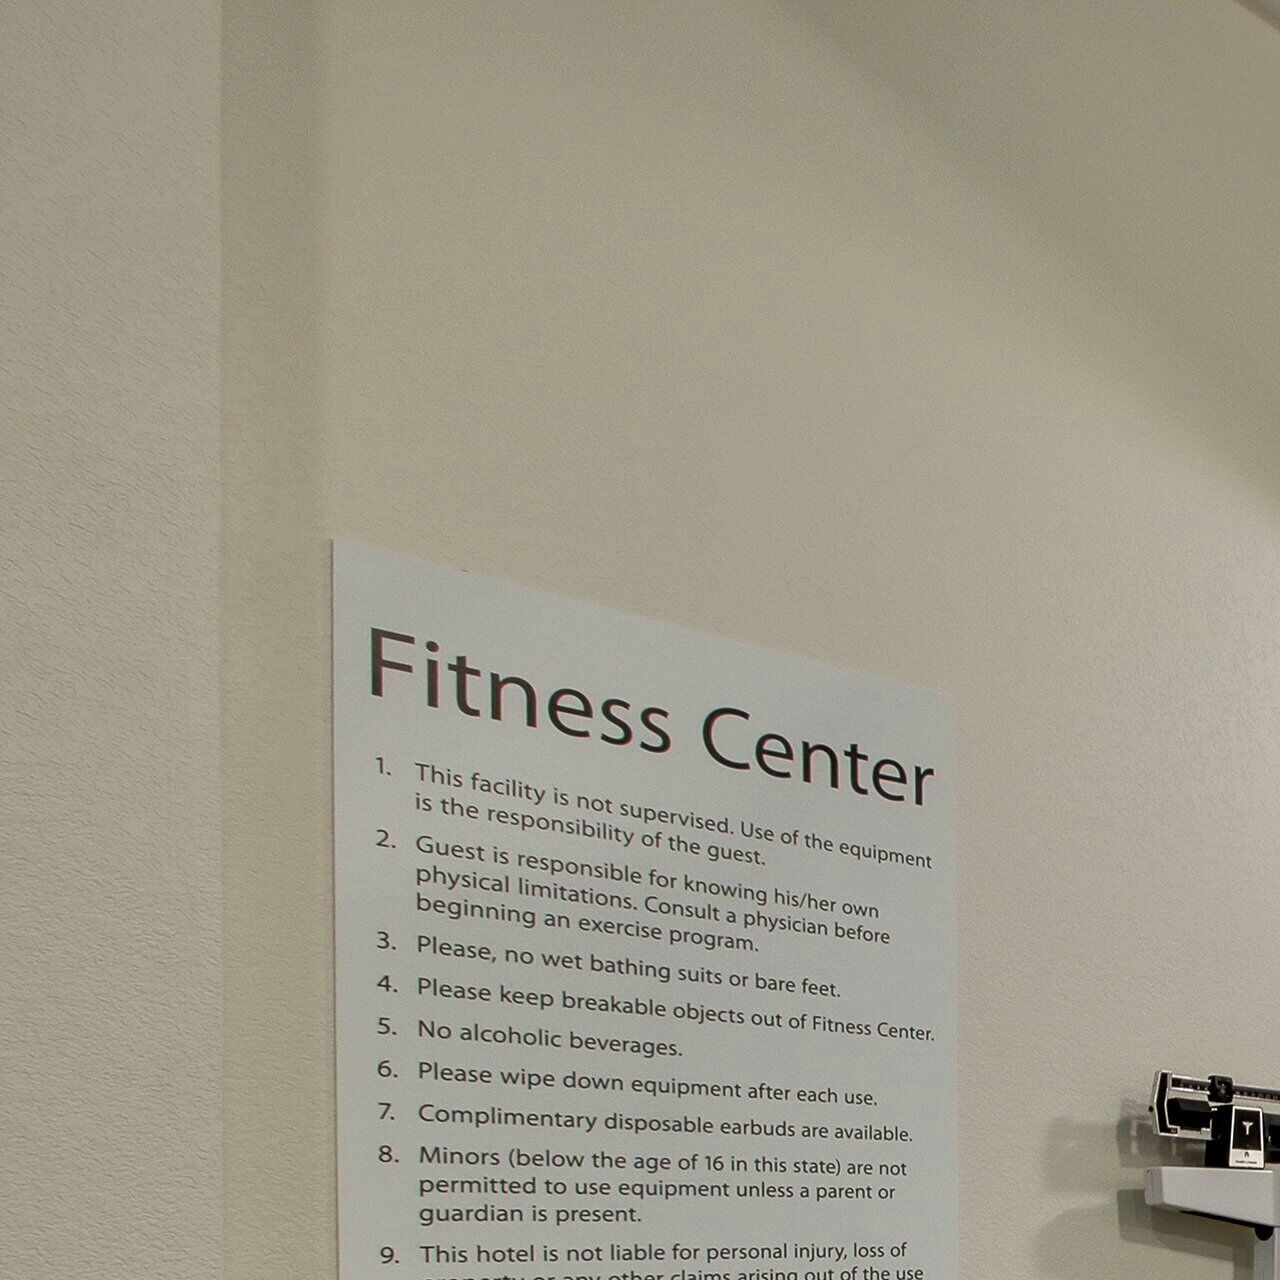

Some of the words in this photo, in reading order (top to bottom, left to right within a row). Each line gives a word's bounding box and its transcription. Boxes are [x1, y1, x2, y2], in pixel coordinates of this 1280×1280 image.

[370, 626, 672, 754] Fitness
[702, 706, 935, 807] Center
[375, 756, 391, 776] 1.
[414, 762, 463, 788] This
[470, 772, 546, 806] facility
[553, 787, 569, 807] is
[576, 795, 613, 814] not
[619, 803, 734, 835] supervised.
[740, 820, 775, 842] Use
[780, 829, 800, 846] of
[804, 832, 834, 852] the
[839, 842, 932, 870] equipment
[415, 792, 433, 812] is
[440, 797, 479, 820] the
[487, 808, 635, 848] responsibility
[641, 831, 663, 848] of
[667, 834, 701, 855] the
[707, 844, 766, 866] guest.
[375, 828, 396, 849] 2.
[415, 835, 485, 862] Guest
[493, 846, 510, 865] is
[518, 854, 643, 885] responsible
[648, 868, 678, 889] for
[684, 874, 768, 907] knowing
[774, 887, 837, 912] his/her
[841, 902, 879, 919] own
[416, 865, 509, 893] physical
[518, 877, 638, 911] limitations.
[644, 895, 720, 922] Consult
[726, 910, 737, 924] a
[743, 910, 828, 936] physician
[834, 921, 891, 945] before
[416, 891, 536, 929] beginning
[543, 913, 571, 929] an
[578, 917, 663, 941] exercise
[669, 929, 759, 952] program.
[376, 930, 397, 951] 3.
[417, 934, 497, 964] Please,
[505, 949, 534, 965] no
[541, 953, 583, 971] wet
[590, 953, 671, 984] bathing
[677, 966, 723, 985] suits
[728, 974, 749, 987] or
[755, 972, 796, 993] bare
[801, 977, 841, 998] feet.
[376, 974, 398, 994] 4.
[417, 977, 492, 1002] Please
[500, 984, 555, 1011] keep
[562, 990, 667, 1017] breakable
[672, 1002, 745, 1025] objects
[750, 1013, 783, 1028] out
[788, 1013, 808, 1030] of
[812, 1015, 872, 1036] Fitness
[876, 1021, 935, 1042] Center.
[377, 1016, 397, 1036] 5.
[418, 1019, 452, 1040] No
[459, 1023, 562, 1048] alcoholic
[569, 1030, 683, 1059] beverages.
[377, 1059, 399, 1078] 6.
[419, 1061, 492, 1084] Please
[499, 1068, 556, 1090] wipe
[562, 1070, 624, 1091] down
[631, 1077, 742, 1099] equipment
[747, 1082, 791, 1101] after
[796, 1087, 838, 1104] each
[844, 1092, 878, 1106] use.
[378, 1102, 395, 1121] 7.
[418, 1103, 598, 1133] Complimentary
[604, 1112, 714, 1135] disposable
[720, 1118, 796, 1137] earbuds
[801, 1125, 829, 1139] are
[834, 1124, 913, 1142] available.
[378, 1144, 400, 1163] 8.
[419, 1145, 501, 1166] Minors
[508, 1148, 585, 1169] (below
[591, 1150, 627, 1169] the
[633, 1156, 672, 1174] age
[677, 1153, 699, 1171] of
[704, 1155, 725, 1172] 16
[730, 1155, 748, 1172] in
[753, 1155, 787, 1173] this
[793, 1158, 841, 1177] state)
[846, 1162, 874, 1176] are
[879, 1162, 907, 1177] not
[419, 1176, 537, 1197] permitted
[543, 1179, 567, 1195] to
[575, 1182, 612, 1196] use
[618, 1179, 730, 1200] equipment
[736, 1181, 794, 1198] unless
[799, 1186, 810, 1199] a
[816, 1186, 873, 1203] parent
[877, 1187, 896, 1200] or
[419, 1203, 524, 1227] guardian
[532, 1204, 548, 1223] is
[556, 1207, 642, 1227] present.
[379, 1246, 400, 1265] 9.
[418, 1245, 468, 1264] This
[476, 1244, 535, 1263] hotel
[543, 1245, 559, 1262] is
[566, 1246, 603, 1262] not
[610, 1243, 666, 1261] liable
[671, 1242, 700, 1260] for
[706, 1242, 788, 1264] personal
[794, 1243, 848, 1263] injury,
[853, 1242, 885, 1258] loss
[890, 1241, 908, 1258] of
[896, 1269, 924, 1280] use
